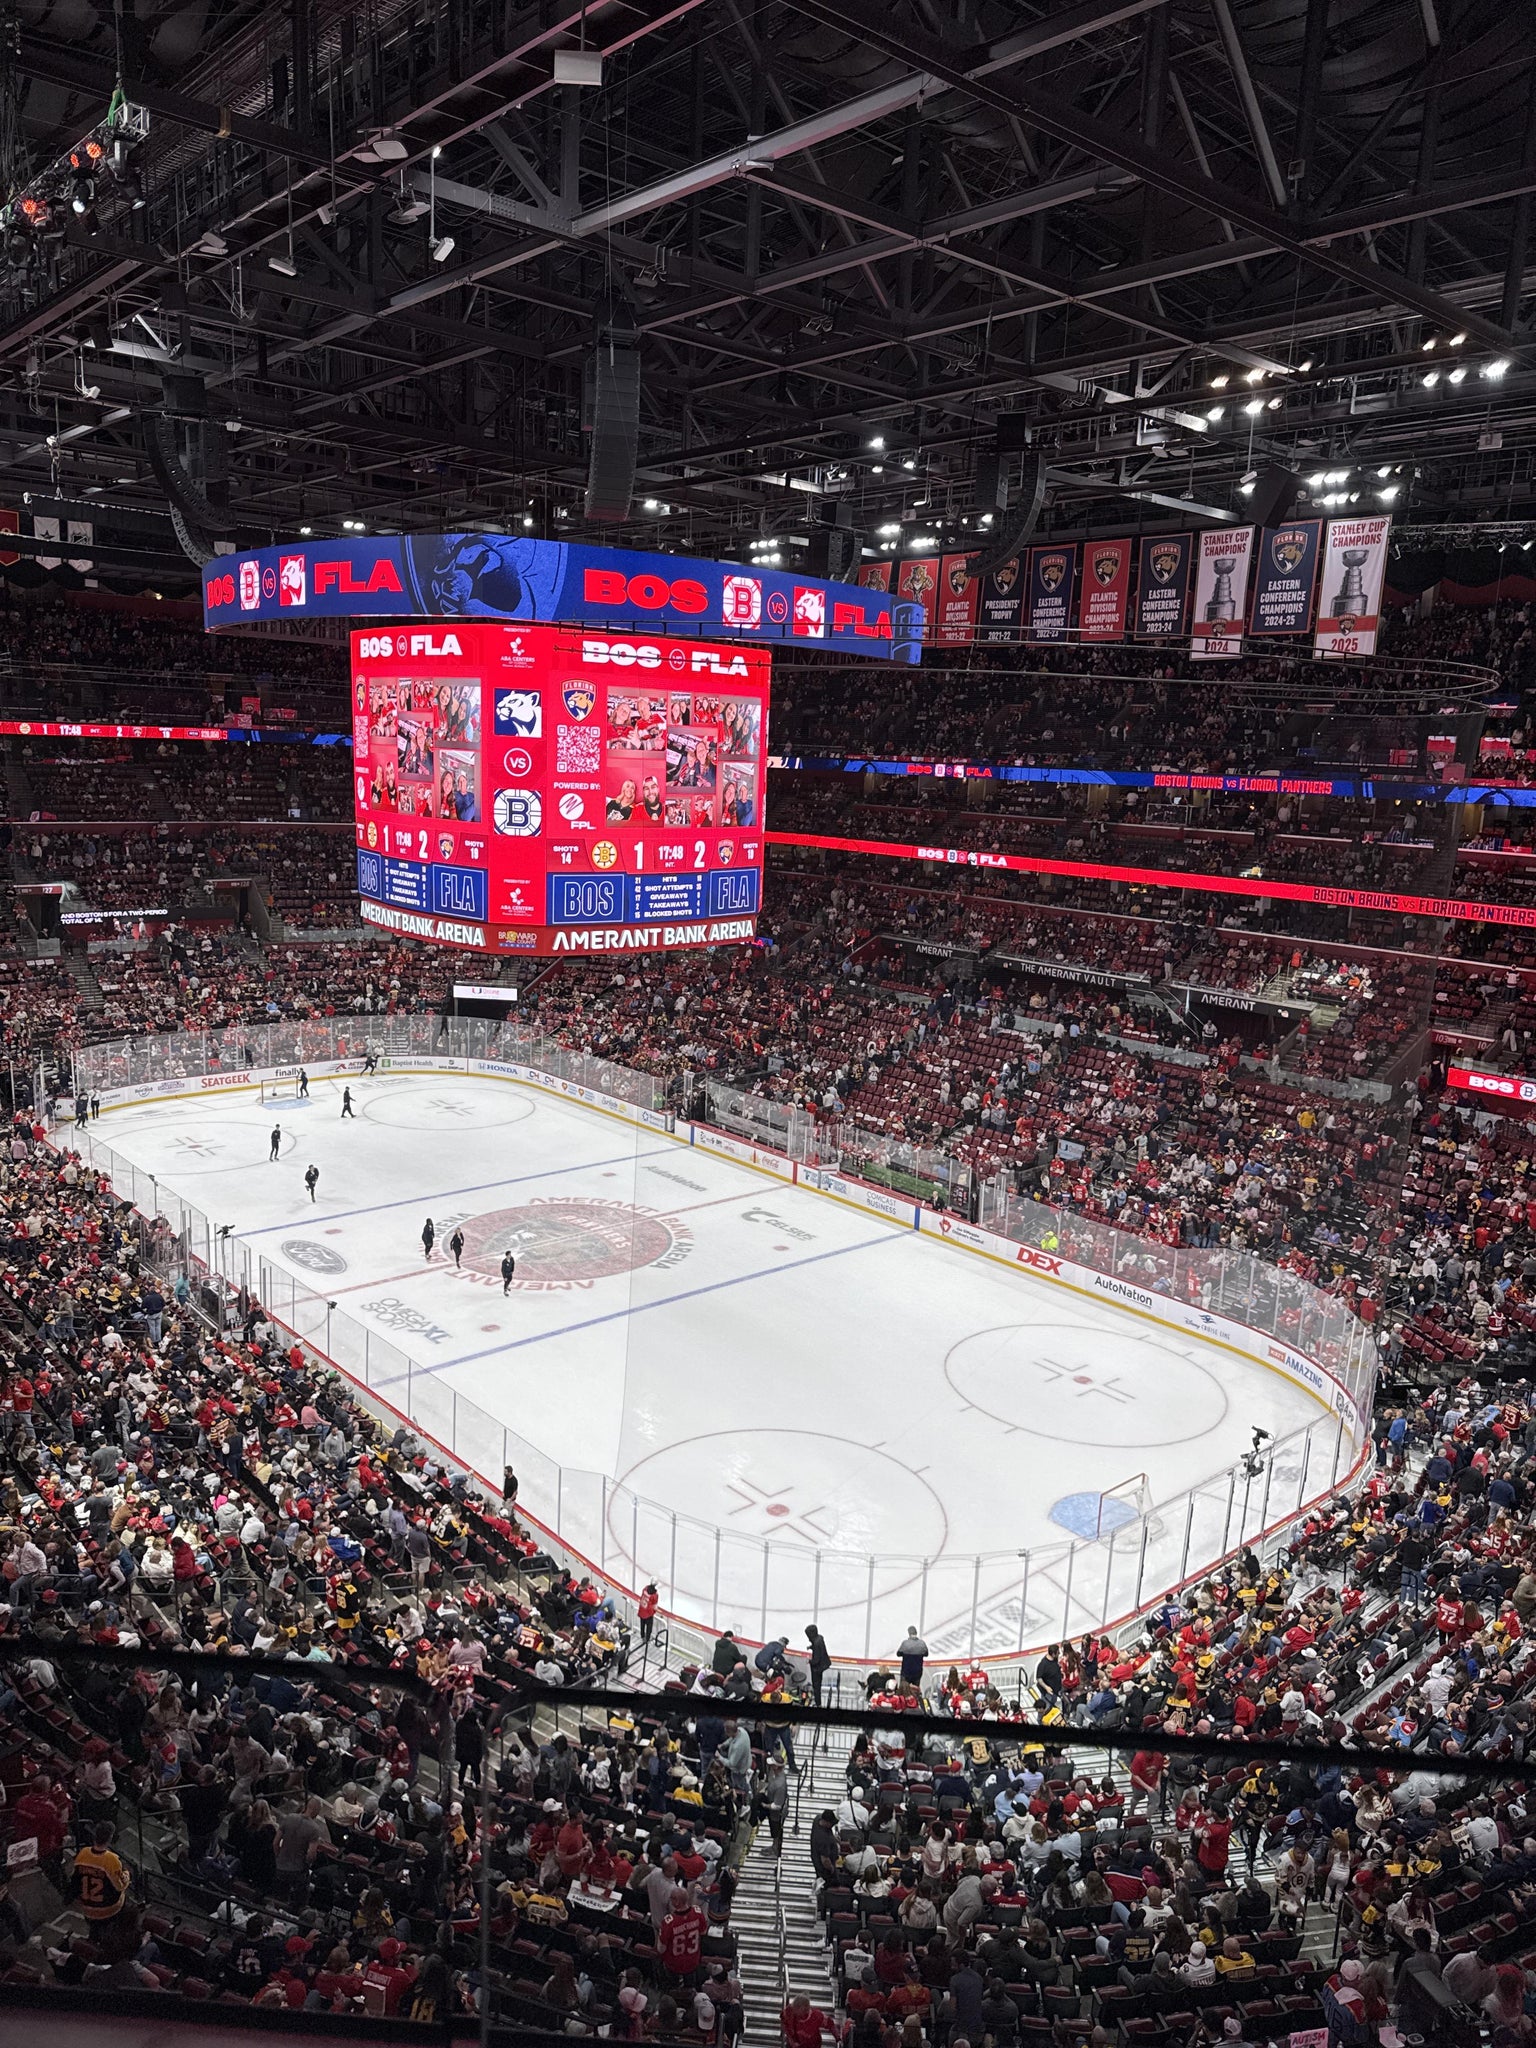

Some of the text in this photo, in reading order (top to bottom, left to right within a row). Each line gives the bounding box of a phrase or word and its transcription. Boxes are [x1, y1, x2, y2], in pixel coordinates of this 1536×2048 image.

[1331, 521, 1386, 537] STANLEY CUP
[1203, 531, 1249, 546] STANLEY CUP
[1332, 533, 1382, 548] CHAMPIONS
[1204, 543, 1246, 557] CHAMPIONS
[206, 574, 235, 610] BOS
[314, 559, 403, 594] FLA
[1268, 579, 1300, 591] EASTERN
[1090, 592, 1118, 602] ATLANTIC
[1148, 588, 1177, 599] EASTERN
[1260, 591, 1306, 603] CONFERENCE
[584, 568, 709, 614] BOS
[833, 602, 894, 639] FLA
[946, 601, 970, 611] ATLANTIC
[1038, 597, 1062, 608] EASTERN
[1089, 602, 1117, 613] DIVISION
[1142, 600, 1181, 611] CONFERENCE
[1259, 603, 1304, 615] CHAMPIONS
[990, 610, 1012, 621] TROPHY
[1032, 607, 1066, 618] CONFERENCE
[1084, 613, 1119, 624] CHAMPIONS
[1142, 611, 1179, 622] CHAMPIONS
[1032, 617, 1065, 628] CHAMPIONS
[1146, 622, 1173, 633] 2023-24
[1264, 616, 1296, 627] 2024-25
[988, 631, 1012, 641] 2021-22
[360, 634, 463, 658] BOS FLA
[1205, 641, 1229, 655] 2024
[1331, 638, 1358, 652] 2025
[582, 641, 749, 677] BOS FLA
[43, 724, 123, 737] 1 17:48 2
[509, 757, 527, 769] VS
[907, 765, 993, 777] BOS FLA
[553, 782, 601, 791] POWERED BY:
[1154, 774, 1333, 795] BOSTON BRUINS VS FLORIDA PANTHERS
[506, 797, 531, 828] B
[570, 821, 597, 830] FPL
[383, 824, 390, 853] 1
[418, 829, 429, 859] 2
[465, 840, 484, 849] SHOTS
[561, 852, 572, 865] 14
[634, 840, 705, 870] 1 17:48 2
[918, 848, 1007, 867] BOS FLA
[361, 856, 378, 892] BOS
[440, 872, 476, 912] FLA
[564, 880, 614, 917] BOS
[650, 892, 689, 900] GIVEAWAYS
[717, 875, 750, 910] FLA
[649, 901, 689, 909] TAKEAWAYS
[1313, 887, 1536, 927] BOSTON BRUINS VS FLORIDA PANTHERS
[76, 911, 103, 919] BOSTON
[128, 908, 168, 917] TWO-PERIOD
[644, 909, 692, 918] BLOCKED SHOTS
[401, 914, 435, 938] BANK
[435, 920, 486, 947] ARENA
[552, 919, 754, 951] AMERANT BANK ARENA
[915, 944, 953, 959] AMERANT
[1020, 962, 1117, 988] THE AMERANT VAULT
[1201, 993, 1256, 1013] AMERANT
[1435, 1033, 1449, 1044] 103
[275, 1068, 300, 1077] finally
[487, 1064, 518, 1075] HONDA
[201, 1073, 251, 1089] SEATGEEK
[1468, 1075, 1515, 1093] BOS
[642, 1165, 707, 1192] AutoNation
[866, 1191, 896, 1207] COMCAST
[866, 1198, 897, 1216] BUSINESS
[529, 1196, 696, 1270] AMERANT BANK ARENA
[765, 1218, 817, 1241] CELSIUS
[963, 1228, 980, 1238] DiMaggio
[969, 1234, 985, 1245] Hospital
[301, 1247, 337, 1270] Ford
[1016, 1247, 1064, 1276] DEX
[1095, 1275, 1153, 1306] AutoNation
[360, 1302, 415, 1331] SPORT
[380, 1297, 432, 1329] OMEGA
[1184, 1316, 1231, 1341] Disney CRUISE LINE
[1285, 1355, 1323, 1389] AMAZING
[1440, 1607, 1457, 1625] 72
[81, 1875, 104, 1902] 12
[672, 1929, 700, 1957] 63
[1291, 2031, 1326, 2046] AUTISM
